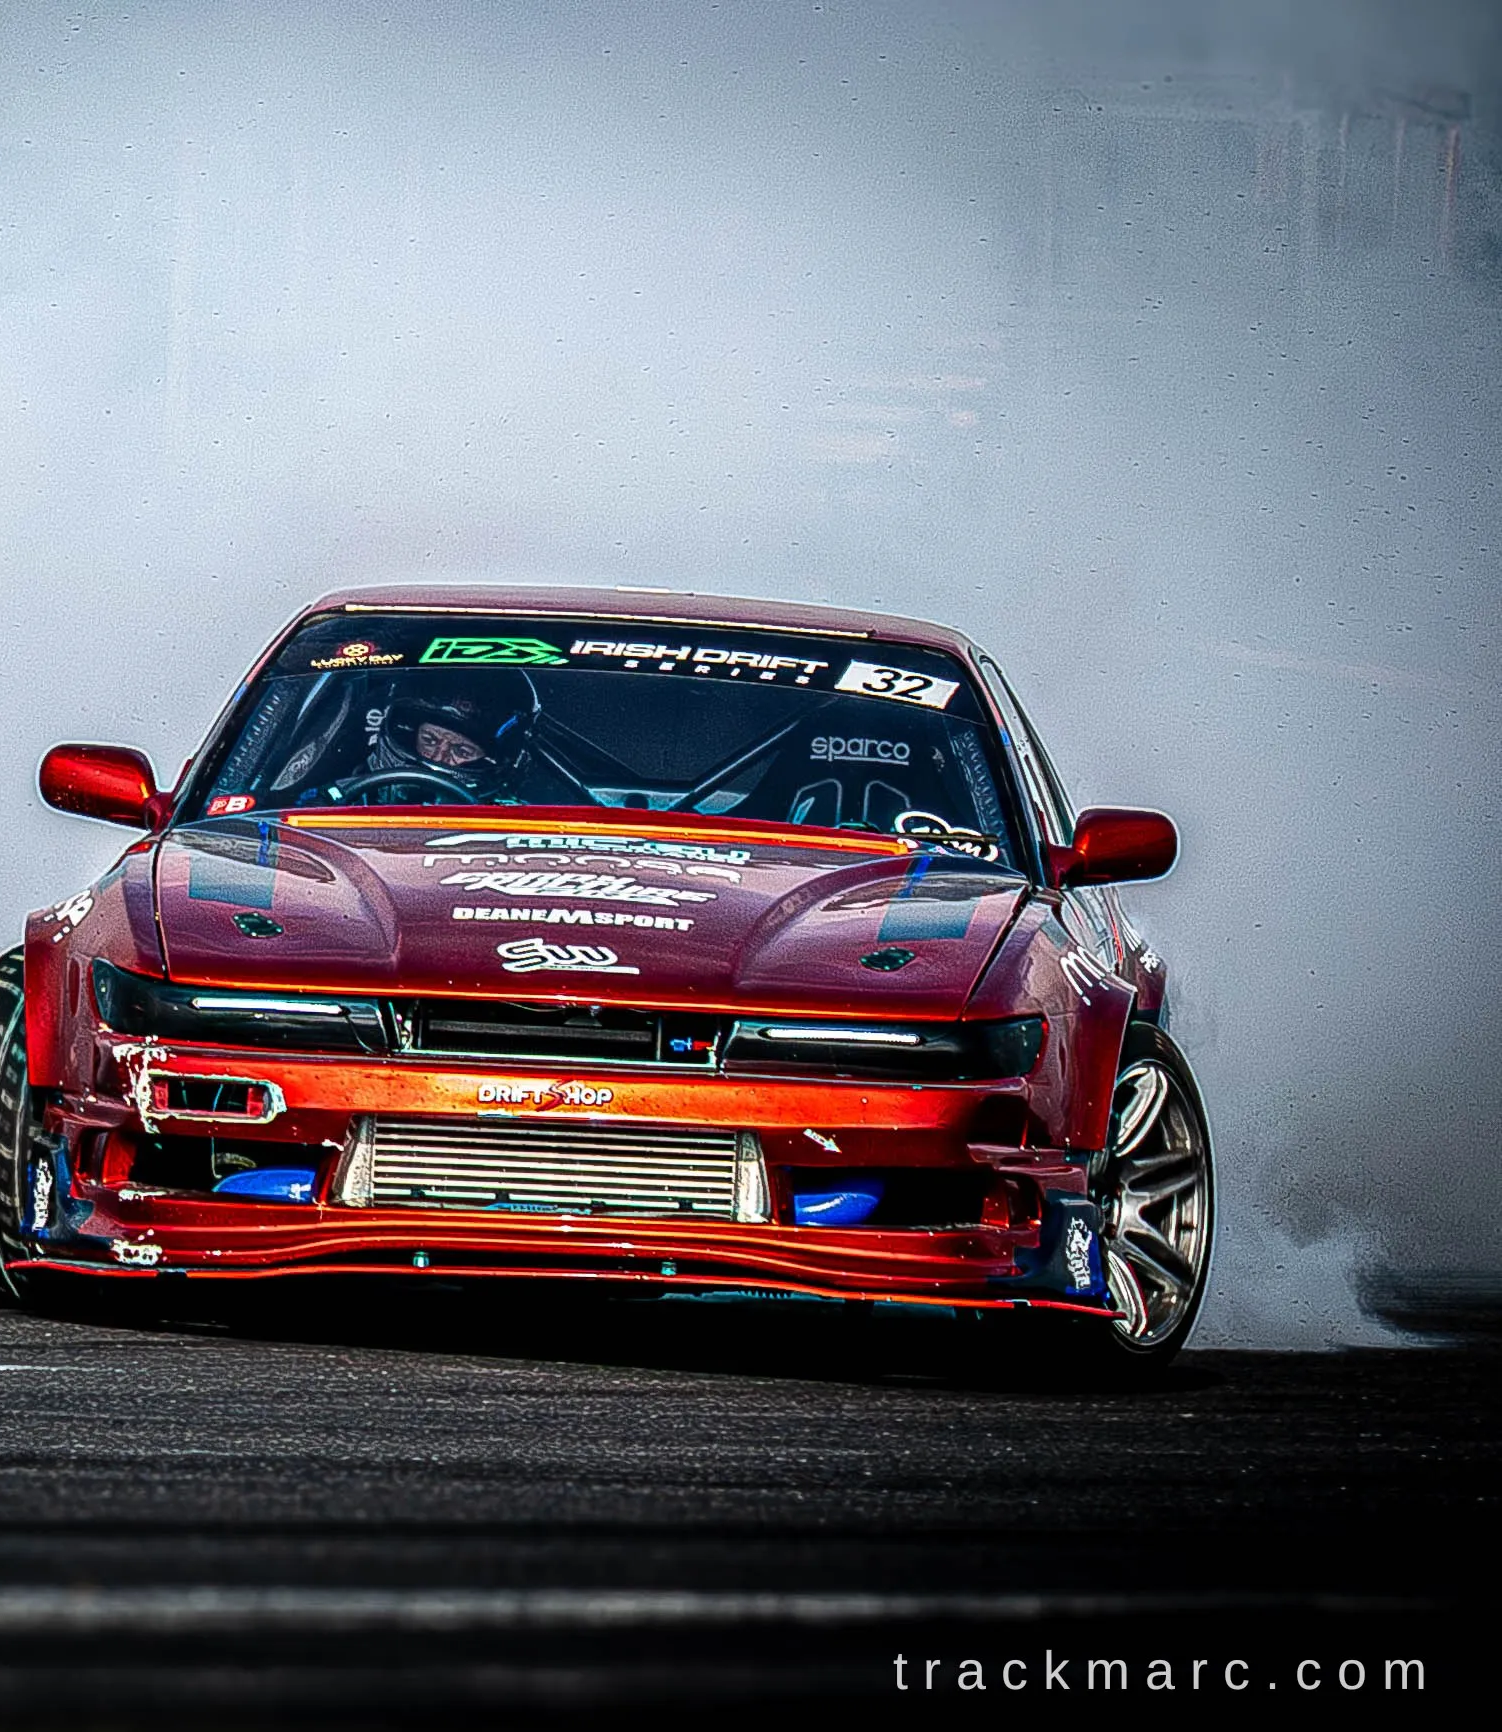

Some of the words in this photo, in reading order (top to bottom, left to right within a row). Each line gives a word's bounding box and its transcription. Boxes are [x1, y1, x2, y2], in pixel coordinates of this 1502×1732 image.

[569, 639, 692, 660] IRISH
[692, 647, 829, 674] DRIFT
[623, 658, 811, 685] SERIES
[861, 667, 935, 701] 32
[811, 736, 911, 763] sparco
